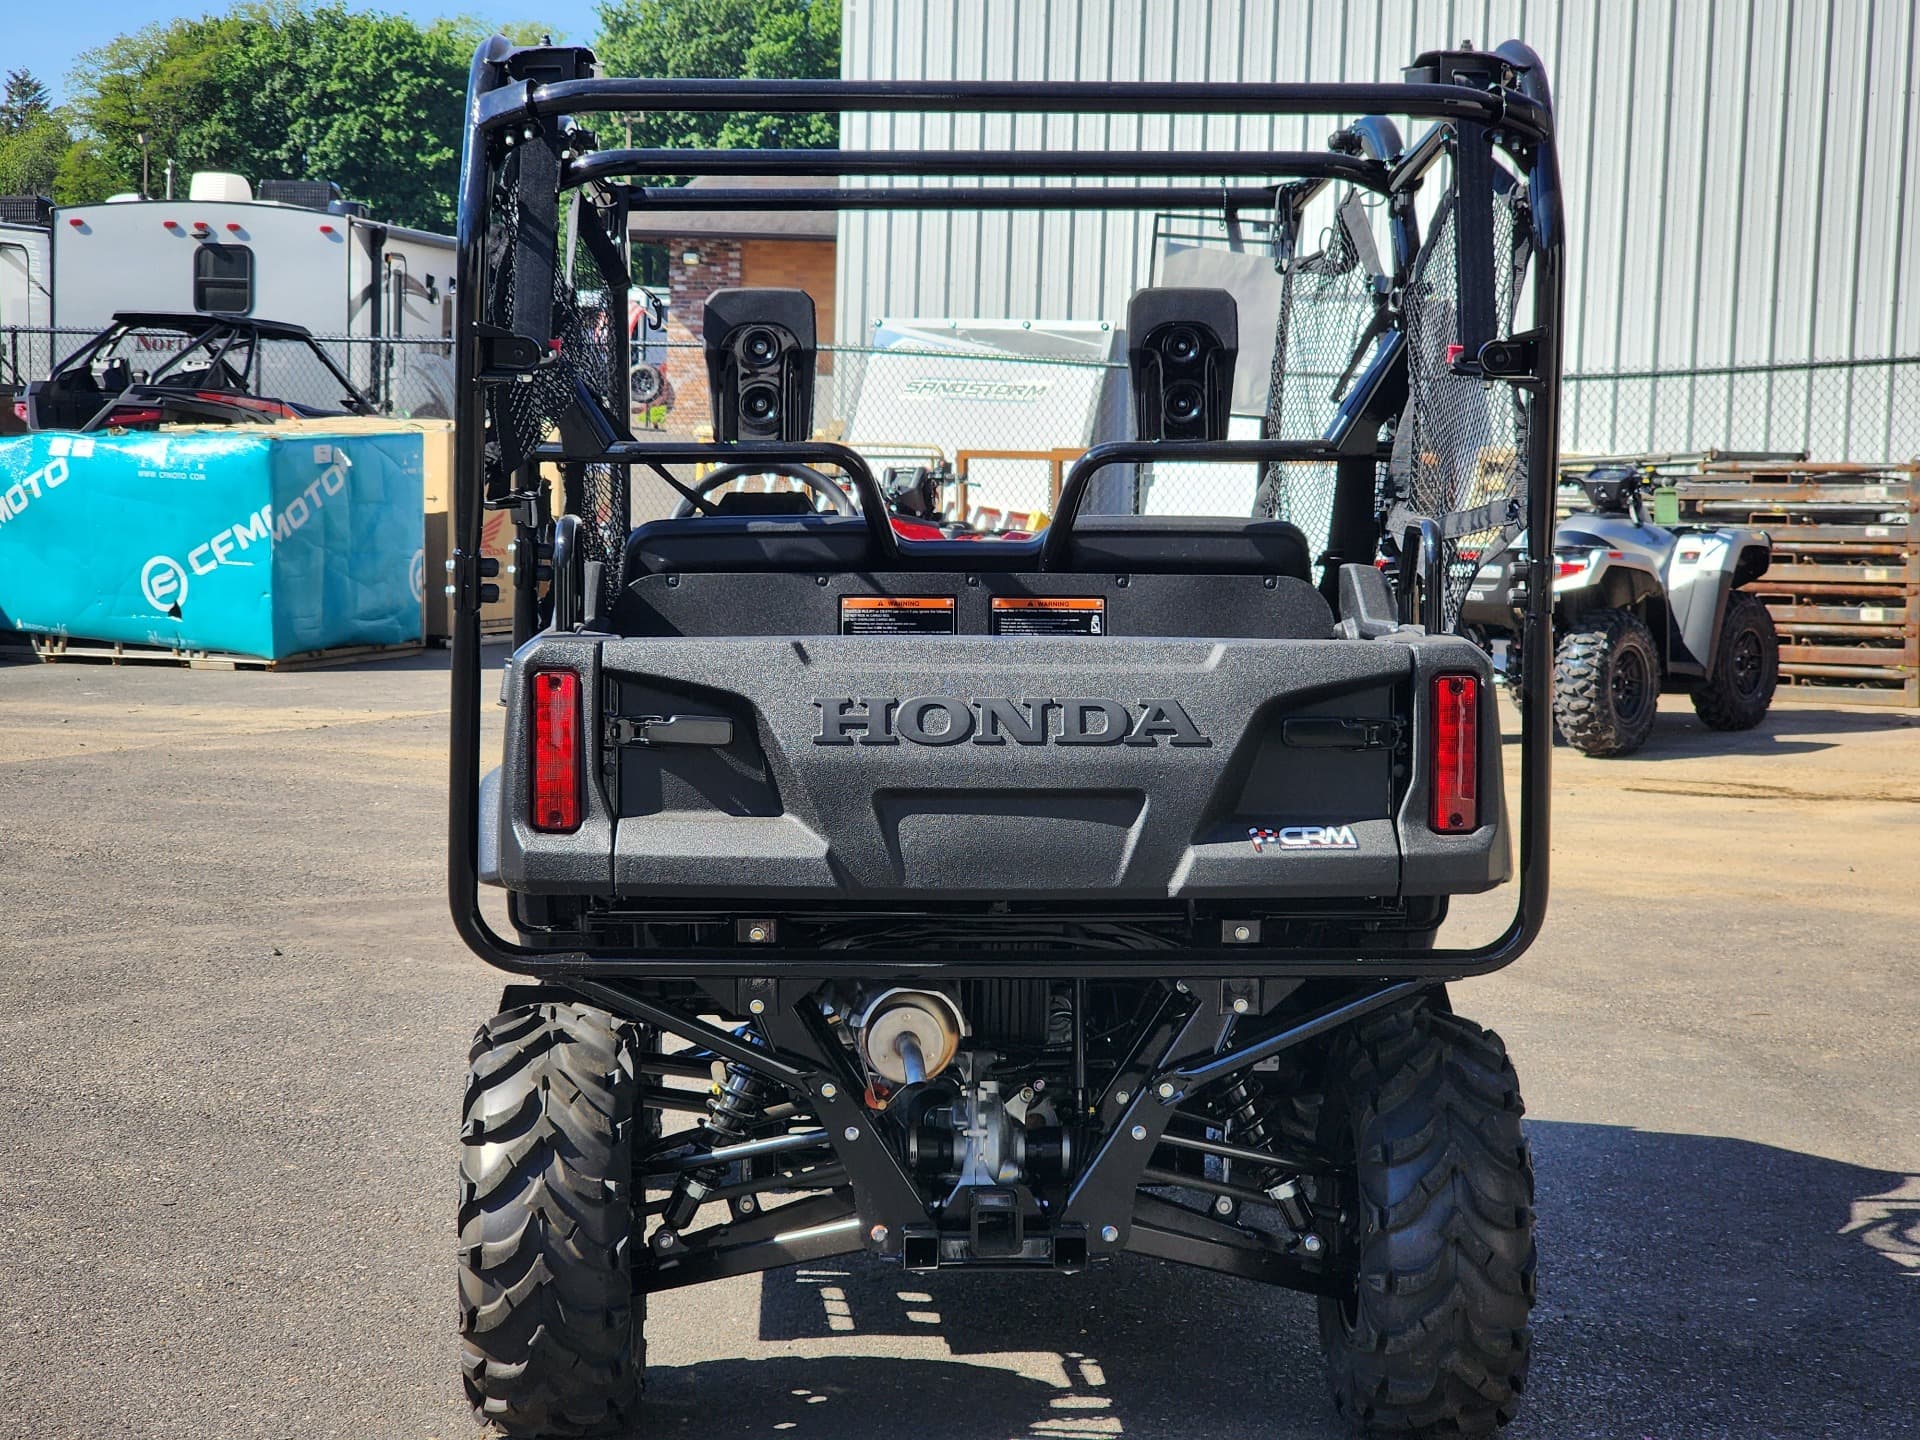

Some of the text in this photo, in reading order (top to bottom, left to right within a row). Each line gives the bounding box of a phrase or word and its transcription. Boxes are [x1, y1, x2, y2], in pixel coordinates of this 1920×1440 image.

[904, 380, 1047, 398] SANDSTORM
[812, 697, 1212, 748] HONDA
[1279, 826, 1357, 845] CRM
